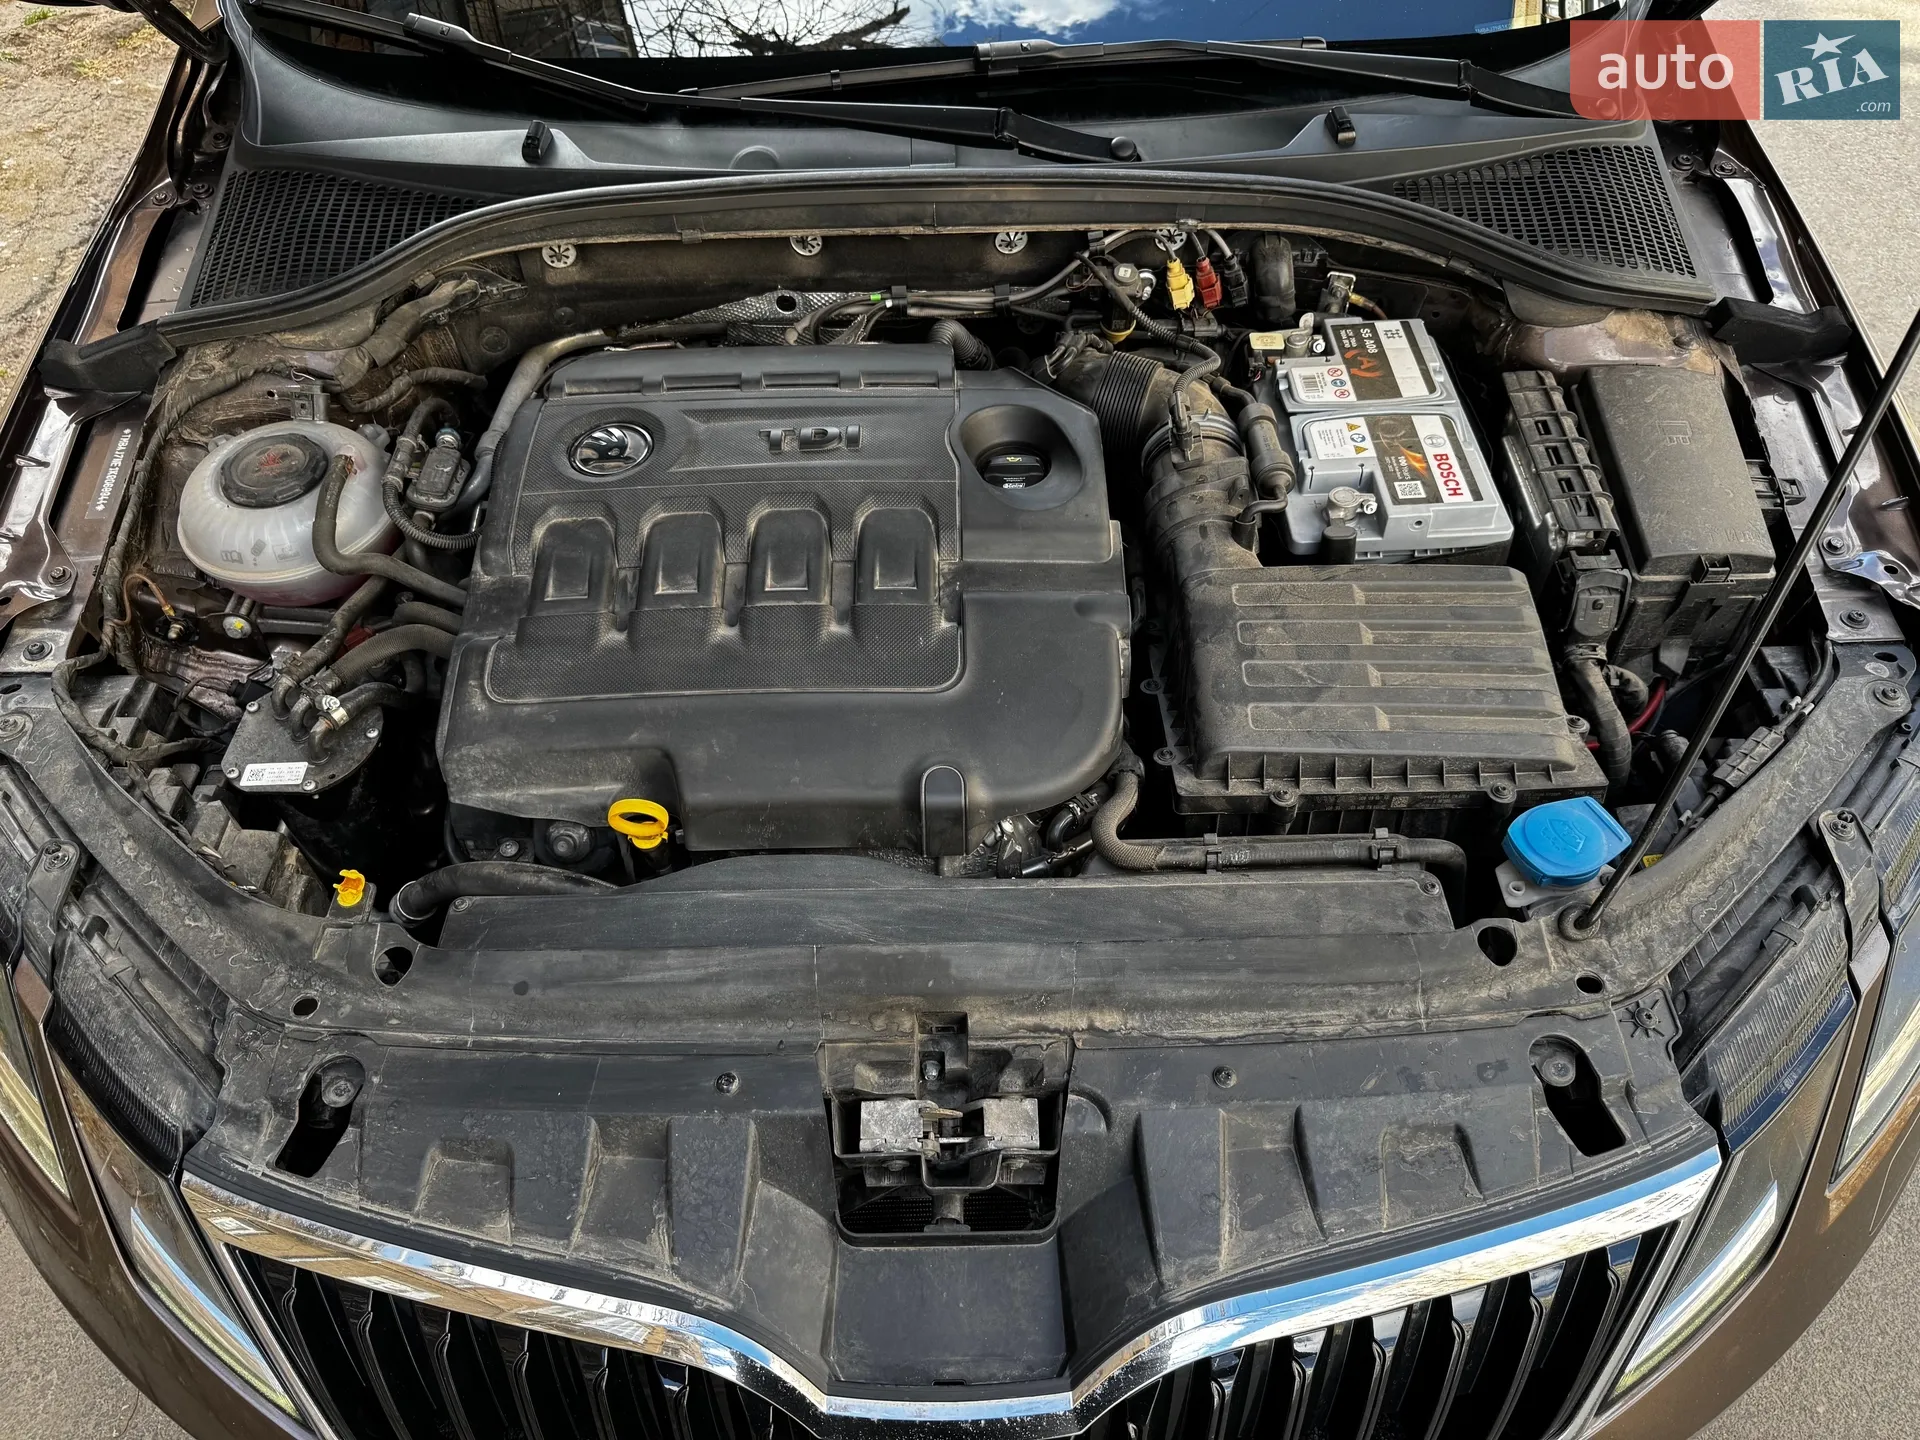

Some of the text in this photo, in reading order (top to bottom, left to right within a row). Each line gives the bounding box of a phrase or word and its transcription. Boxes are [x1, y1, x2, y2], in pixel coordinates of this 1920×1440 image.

[1360, 328, 1378, 354] S5 A08
[758, 424, 861, 452] TDI
[1432, 453, 1464, 497] BOSCH
